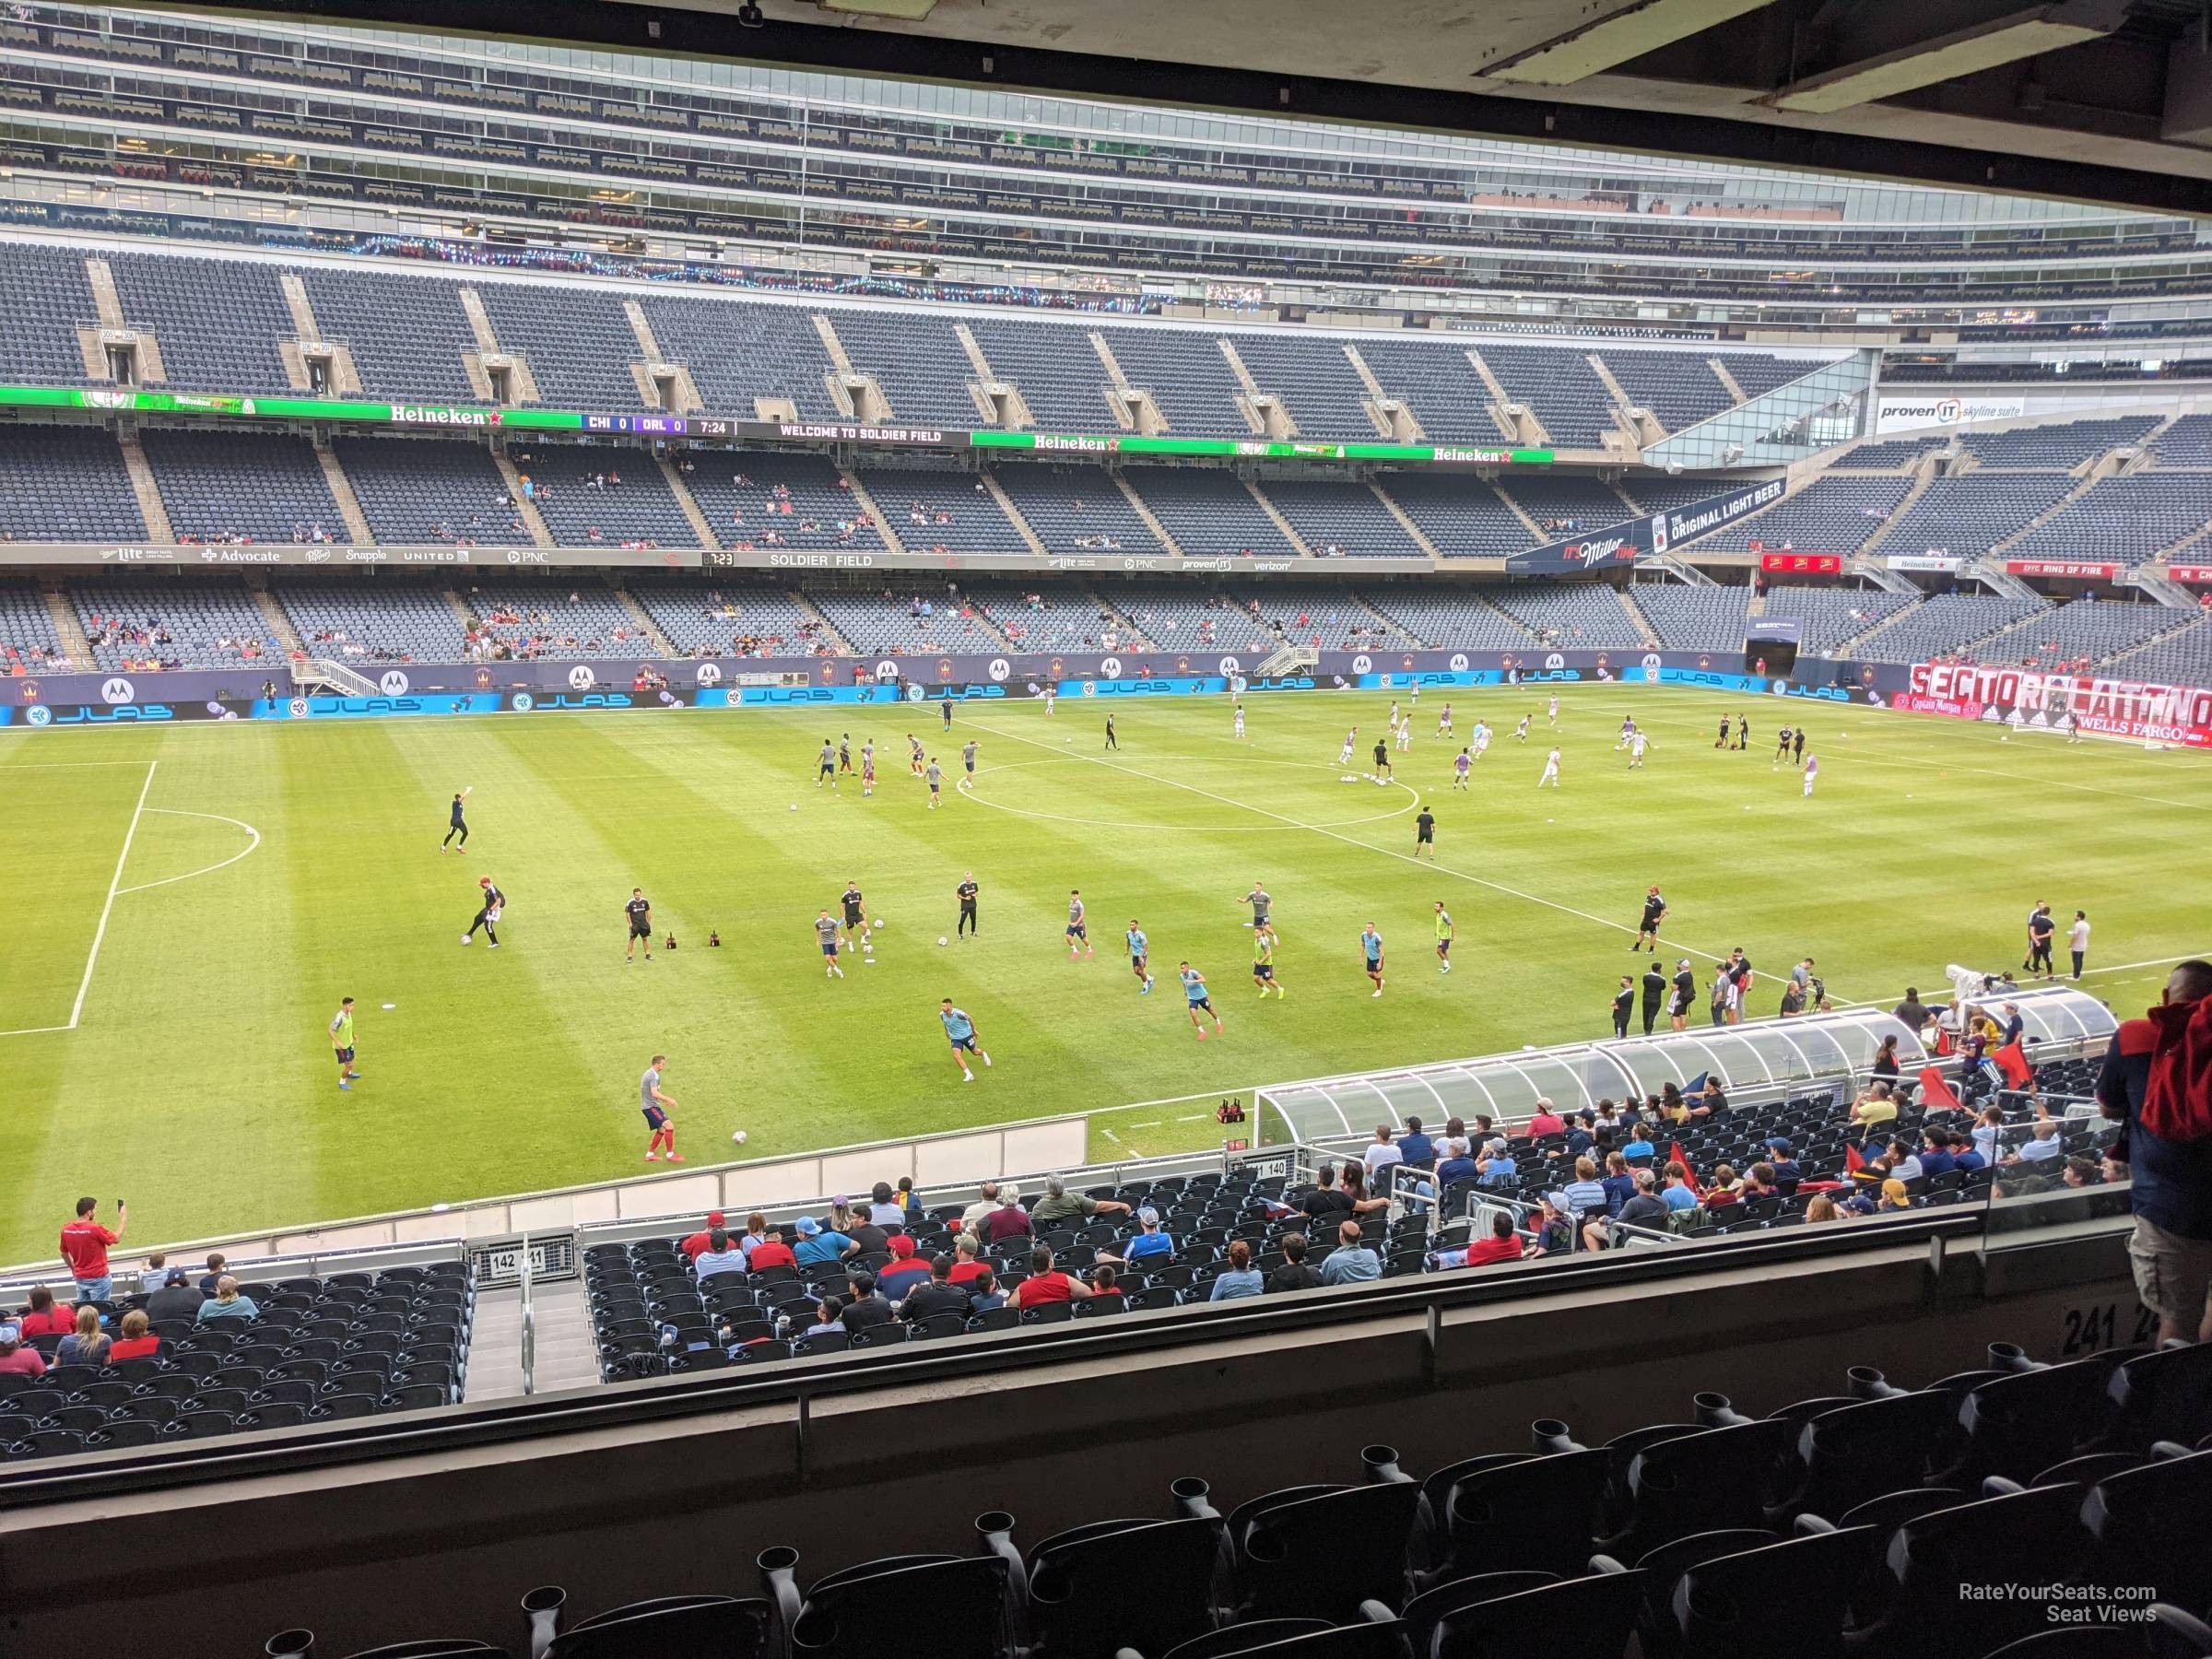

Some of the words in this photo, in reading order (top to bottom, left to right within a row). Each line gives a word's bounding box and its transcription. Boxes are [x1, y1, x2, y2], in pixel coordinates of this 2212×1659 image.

[391, 406, 485, 426] Heineken
[1963, 406, 1995, 420] skyline
[1997, 406, 2020, 417] suite
[589, 417, 611, 429] CHI
[618, 418, 627, 429] 0
[642, 418, 666, 430] ORL
[674, 420, 681, 431] 0
[700, 421, 725, 433] 7:24
[781, 425, 838, 438] WELCOME
[841, 427, 856, 439] TO
[860, 428, 907, 441] SOLDIER
[911, 430, 941, 442] FIELD
[1035, 435, 1106, 451] Heineken
[1433, 448, 1500, 462] Heineken
[1672, 513, 1721, 540] ORIGINAL
[1724, 494, 1753, 520] LIGHT
[1755, 481, 1782, 505] BEER
[1671, 513, 1682, 526] THE
[118, 547, 143, 562] Lite
[220, 550, 280, 561] Advocate
[346, 549, 387, 563] Snapple
[405, 552, 454, 560] UNITED
[523, 552, 548, 562] PNC
[711, 554, 733, 565] 7:23
[1580, 538, 1624, 568] Miller
[771, 555, 828, 567] SOLDIER
[836, 556, 873, 567] FIELD
[1136, 559, 1157, 570] PNC
[1254, 561, 1288, 571] verizon
[1901, 559, 1936, 569] Heineken
[2043, 565, 2065, 574] RING
[2066, 566, 2079, 574] OF
[2082, 567, 2102, 575] FIRE
[1910, 664, 2041, 710] SECTOR
[2079, 715, 2128, 734] WELLS
[2133, 722, 2183, 741] FARGO
[1269, 1162, 1284, 1175] 140
[493, 1253, 515, 1269] 142
[2063, 1304, 2117, 1355] 241
